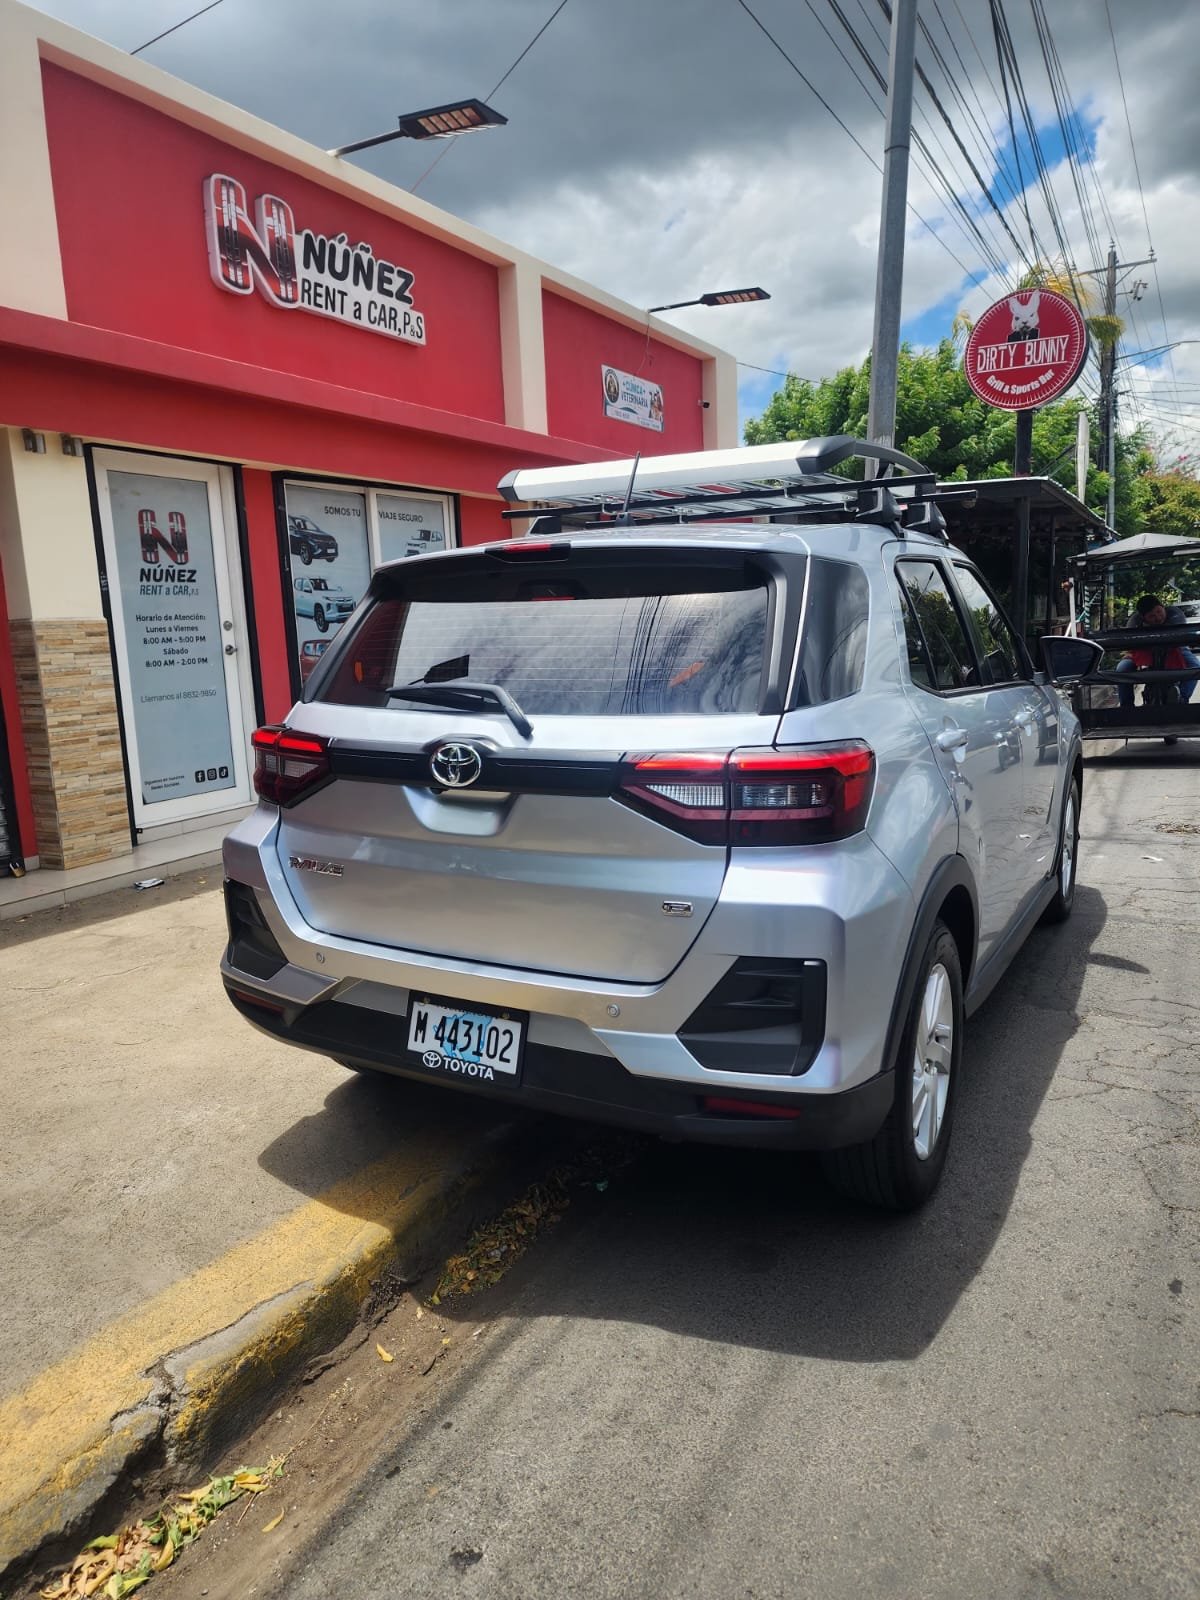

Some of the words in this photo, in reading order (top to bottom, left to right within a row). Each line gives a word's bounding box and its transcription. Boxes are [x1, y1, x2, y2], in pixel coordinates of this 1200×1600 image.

[302, 233, 414, 305] NÚÑEZ
[301, 278, 348, 315] RENT
[353, 301, 362, 320] a
[977, 344, 1018, 371] DIRTY
[1024, 336, 1069, 366] BUNNY
[986, 374, 1005, 391] Grill
[1003, 385, 1009, 394] &
[1010, 380, 1041, 395] Sports
[1038, 369, 1055, 385] Bar
[324, 505, 351, 516] SOMOS
[352, 507, 361, 518] TU
[378, 511, 397, 520] VIAJE
[398, 513, 424, 523] SEGURO
[139, 564, 197, 583] NÚÑEZ
[140, 585, 163, 596] RENT
[165, 587, 170, 596] a
[135, 614, 162, 622] Horario
[143, 637, 159, 645] 8:00
[163, 647, 189, 655] Sábado
[181, 658, 196, 666] 2:00
[414, 1010, 428, 1044] M
[434, 1015, 514, 1064] 443102
[443, 1056, 495, 1081] TOYOTA
